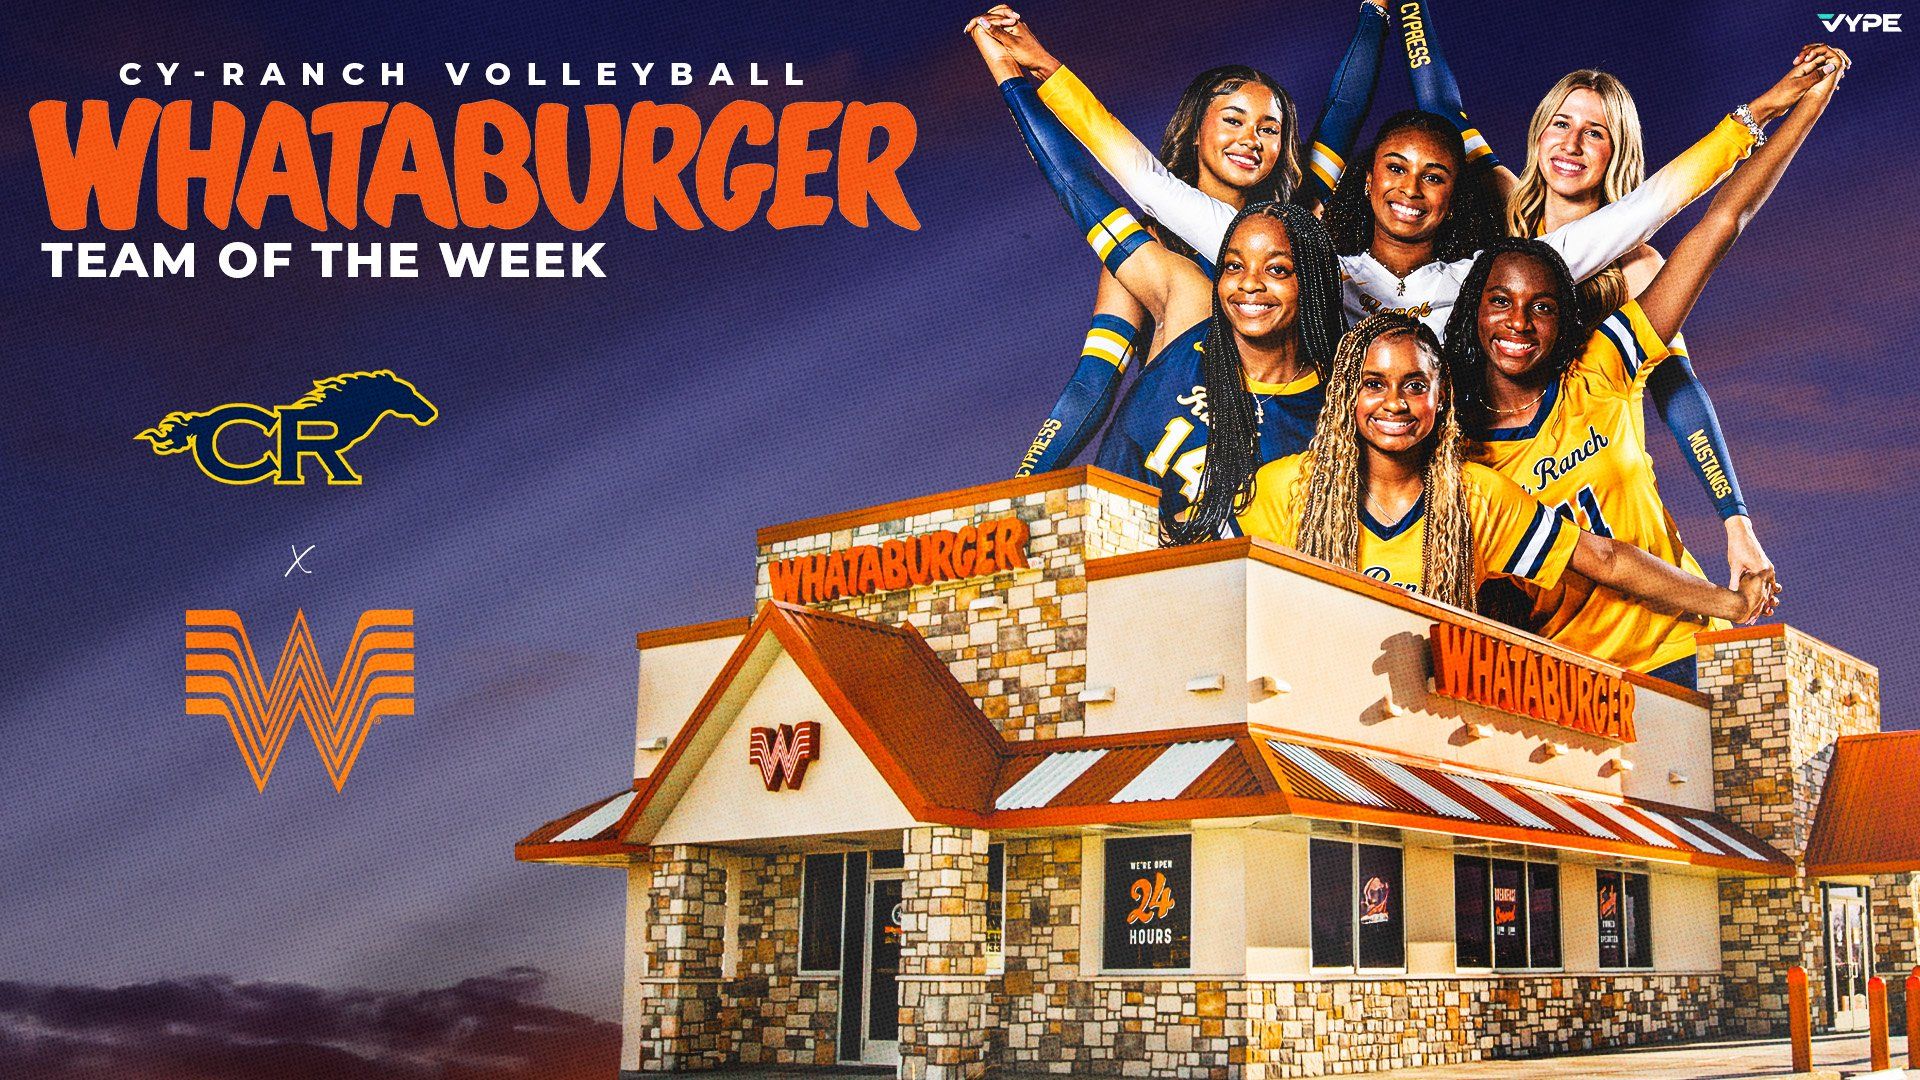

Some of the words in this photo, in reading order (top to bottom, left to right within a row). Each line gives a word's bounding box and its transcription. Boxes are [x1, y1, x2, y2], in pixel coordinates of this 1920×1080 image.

[1400, 2, 1431, 69] CYPRESS
[1533, 425, 1609, 490] Ranch
[1687, 428, 1732, 499] MUSTANGS
[768, 516, 1030, 604] WHATABURGER
[1430, 621, 1637, 744] WHATABURGER
[1154, 859, 1173, 869] OPEN
[1126, 871, 1175, 925] 24
[1129, 928, 1172, 945] HOURS
